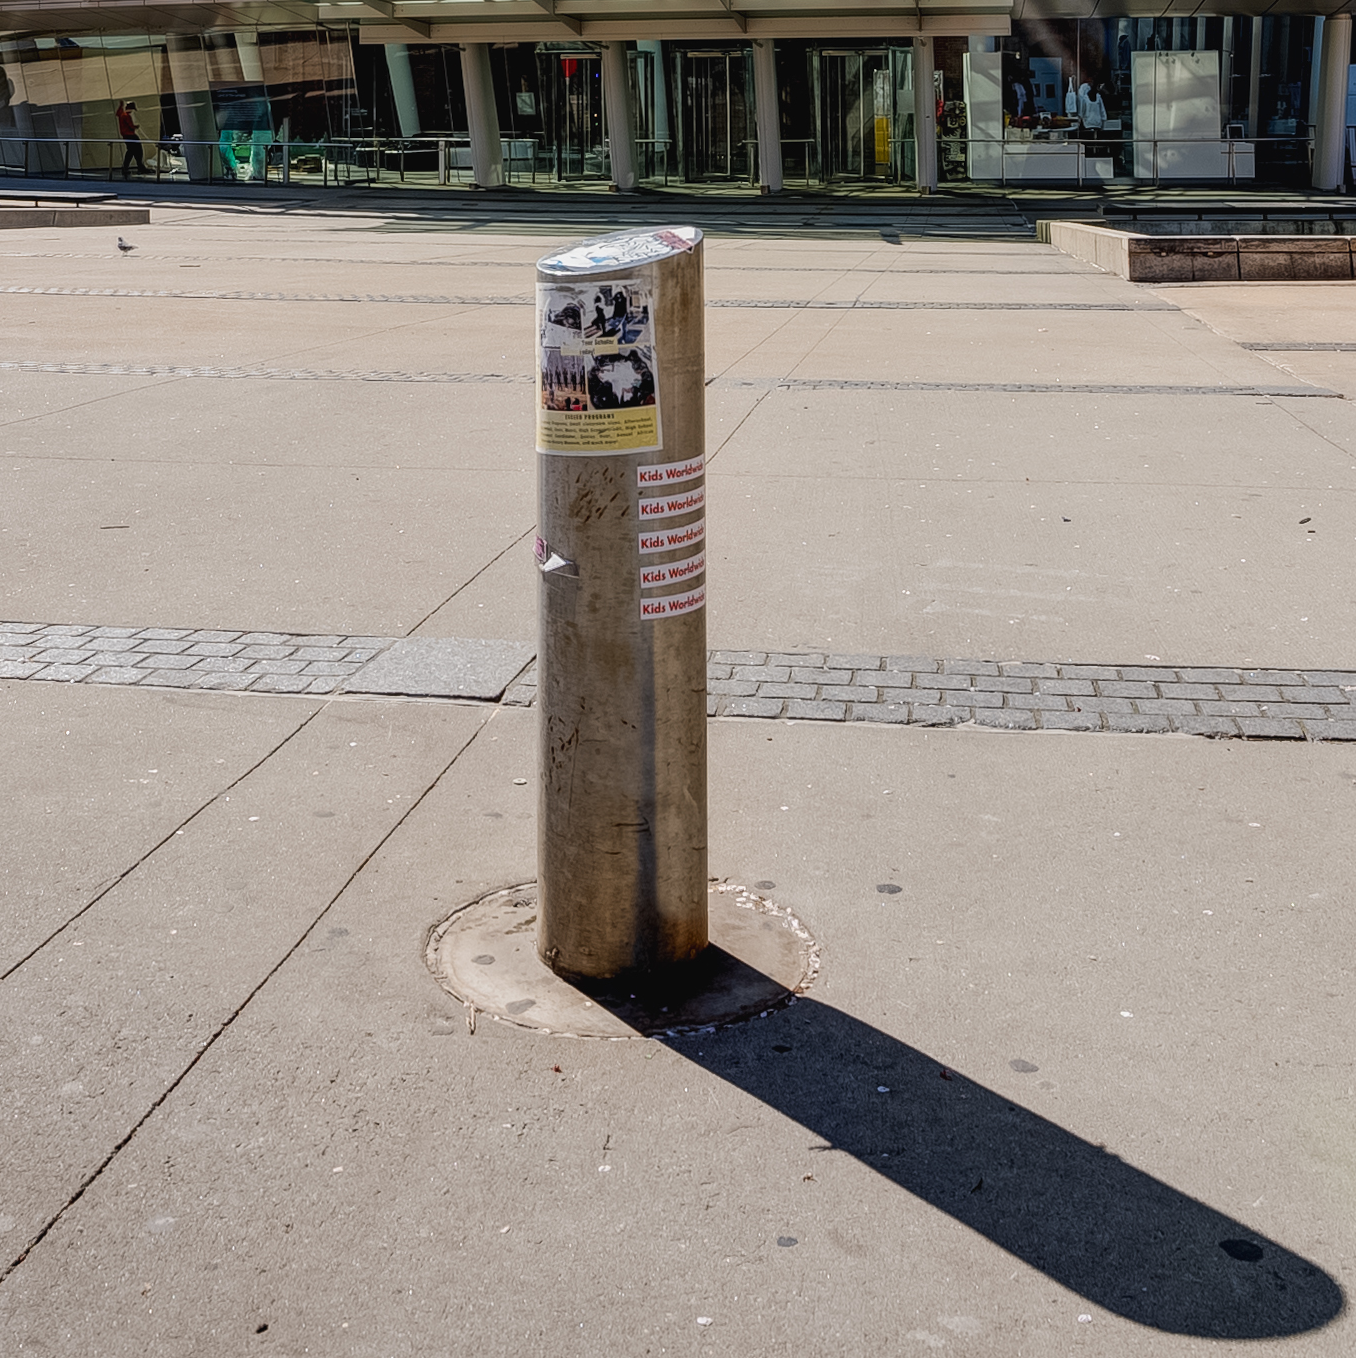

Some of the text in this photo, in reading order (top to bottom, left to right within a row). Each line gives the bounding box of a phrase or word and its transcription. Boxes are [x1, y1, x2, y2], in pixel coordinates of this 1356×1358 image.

[639, 459, 704, 482] Kids Worldwid
[641, 491, 704, 515] Kids Worldwid
[641, 524, 704, 549] Kids Worldwid
[642, 556, 705, 584] Kids Worldwid
[642, 591, 705, 615] Kids Worldwid
